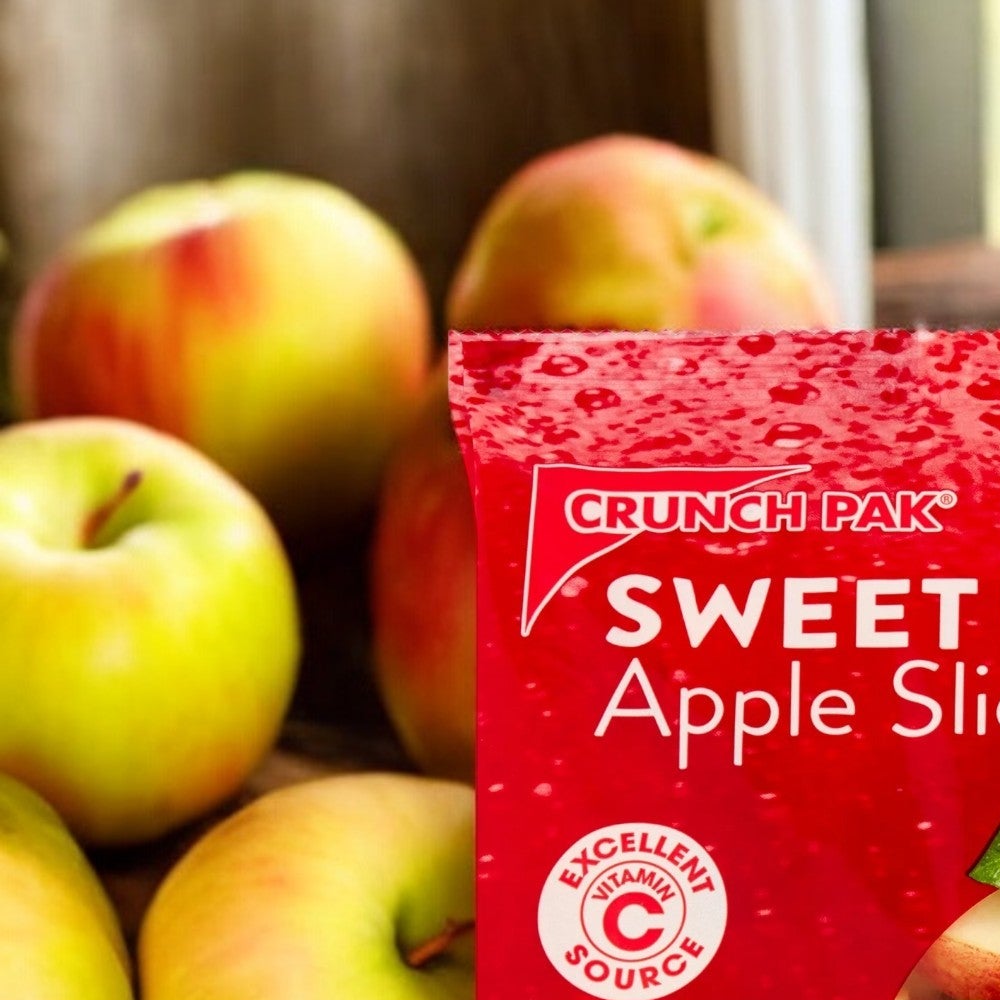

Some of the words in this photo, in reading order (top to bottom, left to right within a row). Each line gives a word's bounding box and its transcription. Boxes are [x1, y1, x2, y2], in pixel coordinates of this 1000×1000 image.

[565, 489, 807, 533] CRUNCH
[606, 573, 978, 650] SWEET
[594, 657, 855, 770] Apple
[558, 832, 715, 896] EXCELLENT
[591, 868, 676, 903] VITAMIN
[603, 891, 664, 951] C
[565, 936, 704, 990] SOURCE
